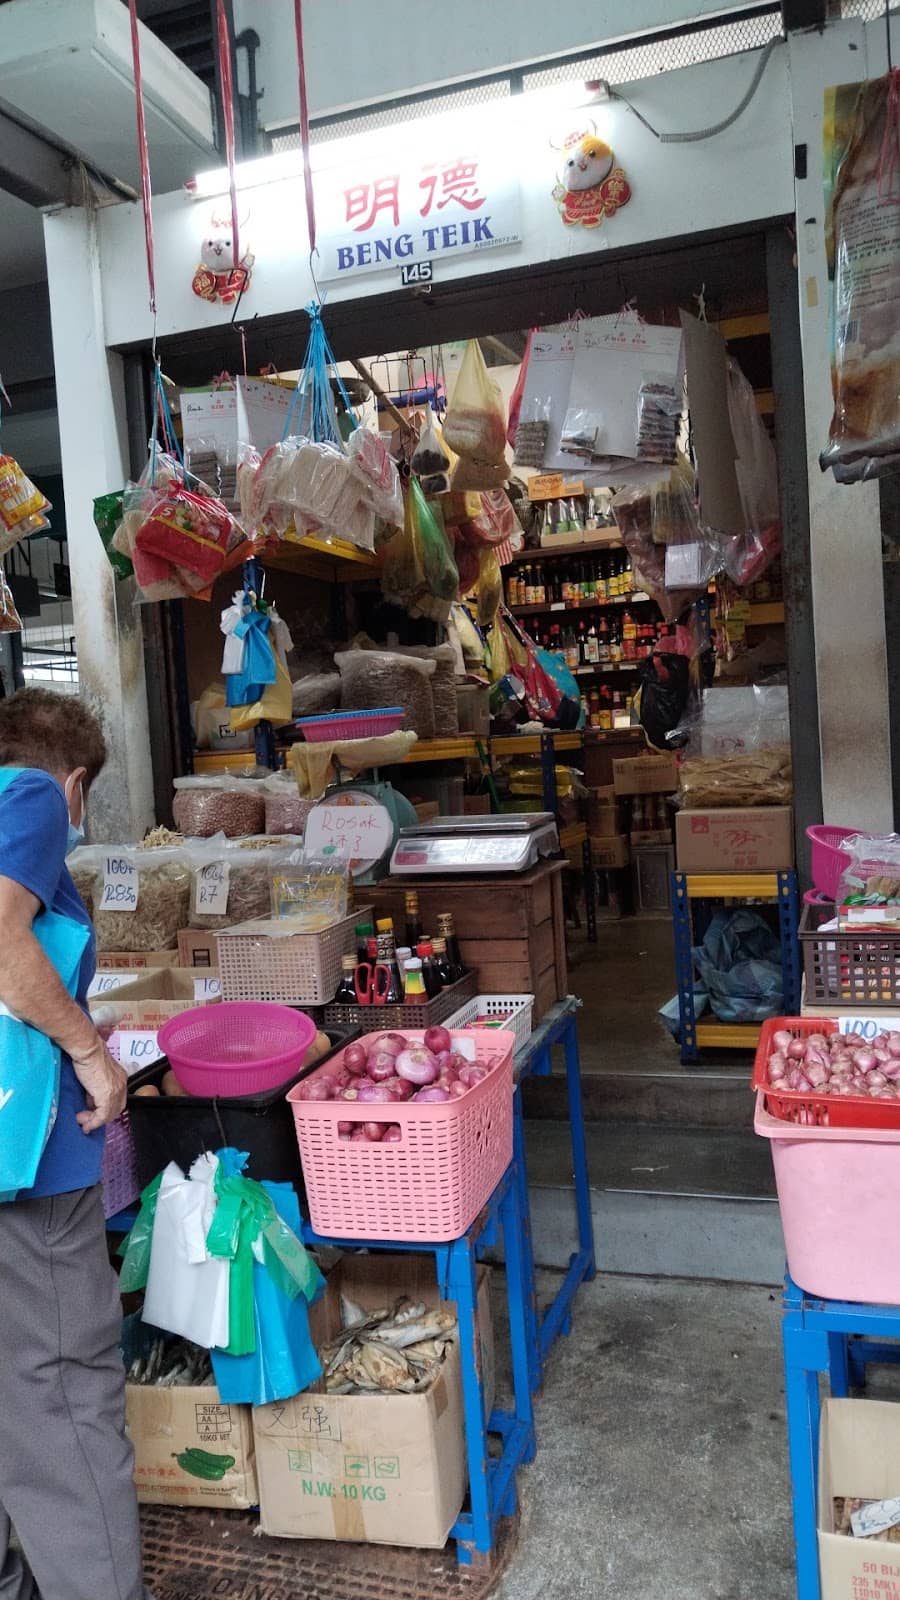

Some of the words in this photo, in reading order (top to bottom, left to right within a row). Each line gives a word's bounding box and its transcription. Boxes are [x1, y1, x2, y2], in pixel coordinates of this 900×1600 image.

[337, 233, 414, 270] BENG
[422, 216, 494, 252] TEIK
[402, 263, 432, 284] 145
[201, 1415, 212, 1423] AA
[341, 1484, 358, 1499] 10
[362, 1485, 387, 1501] KG
[863, 1562, 877, 1574] 50
